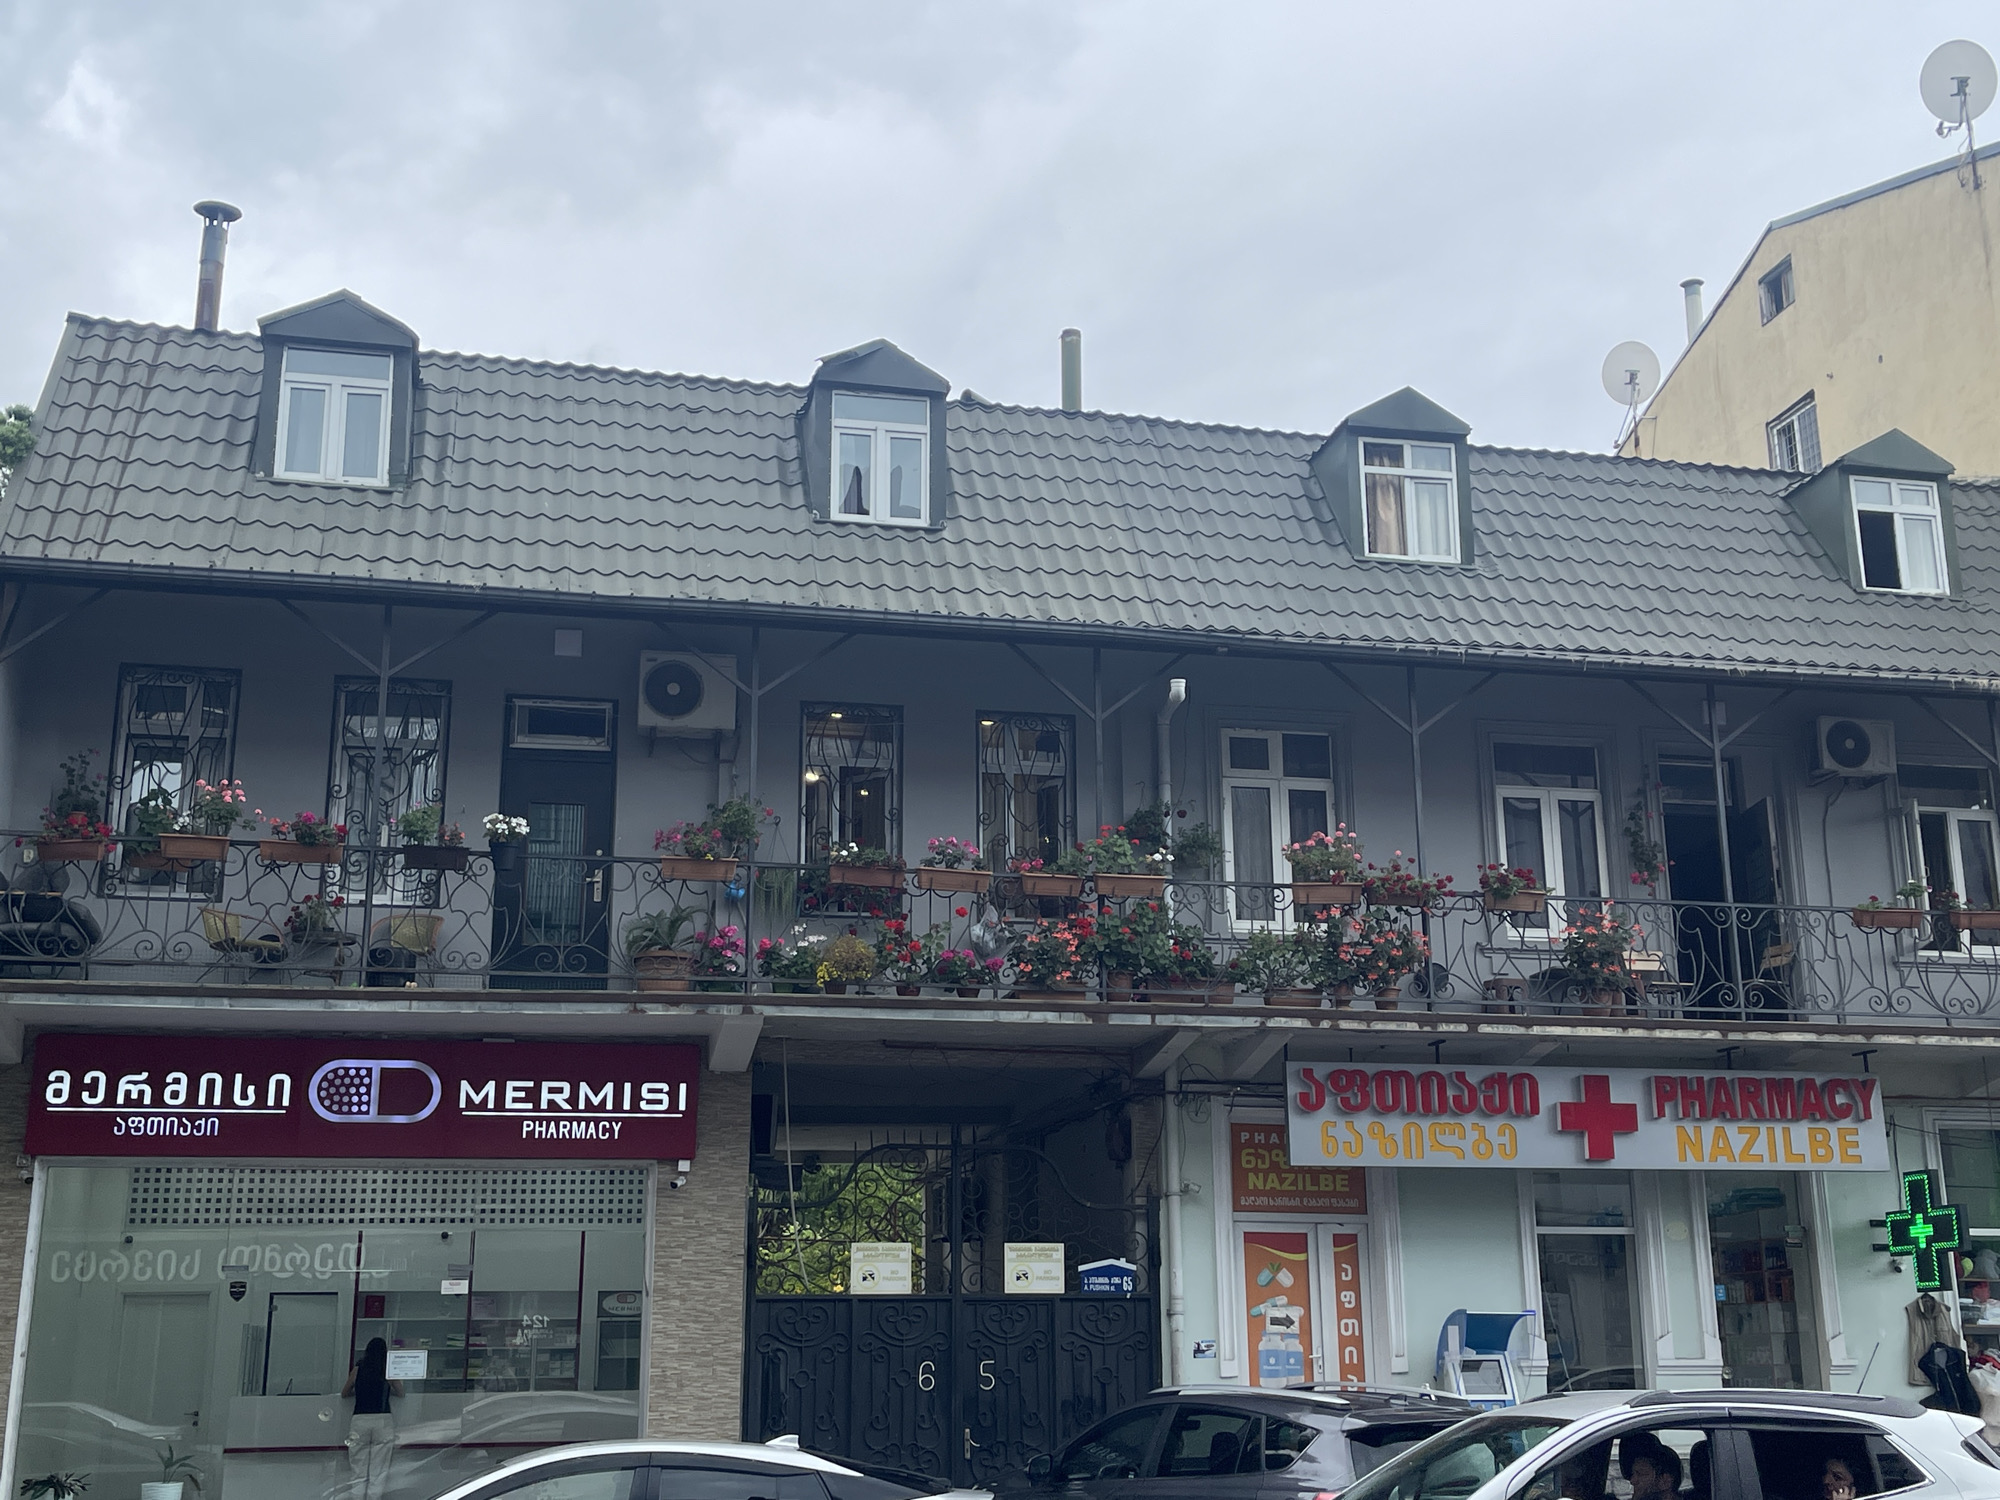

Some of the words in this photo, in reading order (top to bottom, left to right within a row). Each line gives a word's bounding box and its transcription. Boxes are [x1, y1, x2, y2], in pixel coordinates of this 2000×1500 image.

[45, 1069, 292, 1107] მერმისი
[459, 1079, 687, 1111] MERMISI
[1296, 1067, 1541, 1116] აფთიაქი
[1652, 1075, 1877, 1121] PHARMACY
[113, 1116, 219, 1136] აფთიაქი
[522, 1120, 622, 1140] PHARMACY
[1320, 1119, 1519, 1160] ნაზილბე
[1676, 1125, 1863, 1164] NAZILBE
[1247, 1172, 1350, 1192] NAZILBE
[1123, 1276, 1133, 1291] 65
[918, 1360, 935, 1391] 6
[979, 1360, 995, 1391] 5
